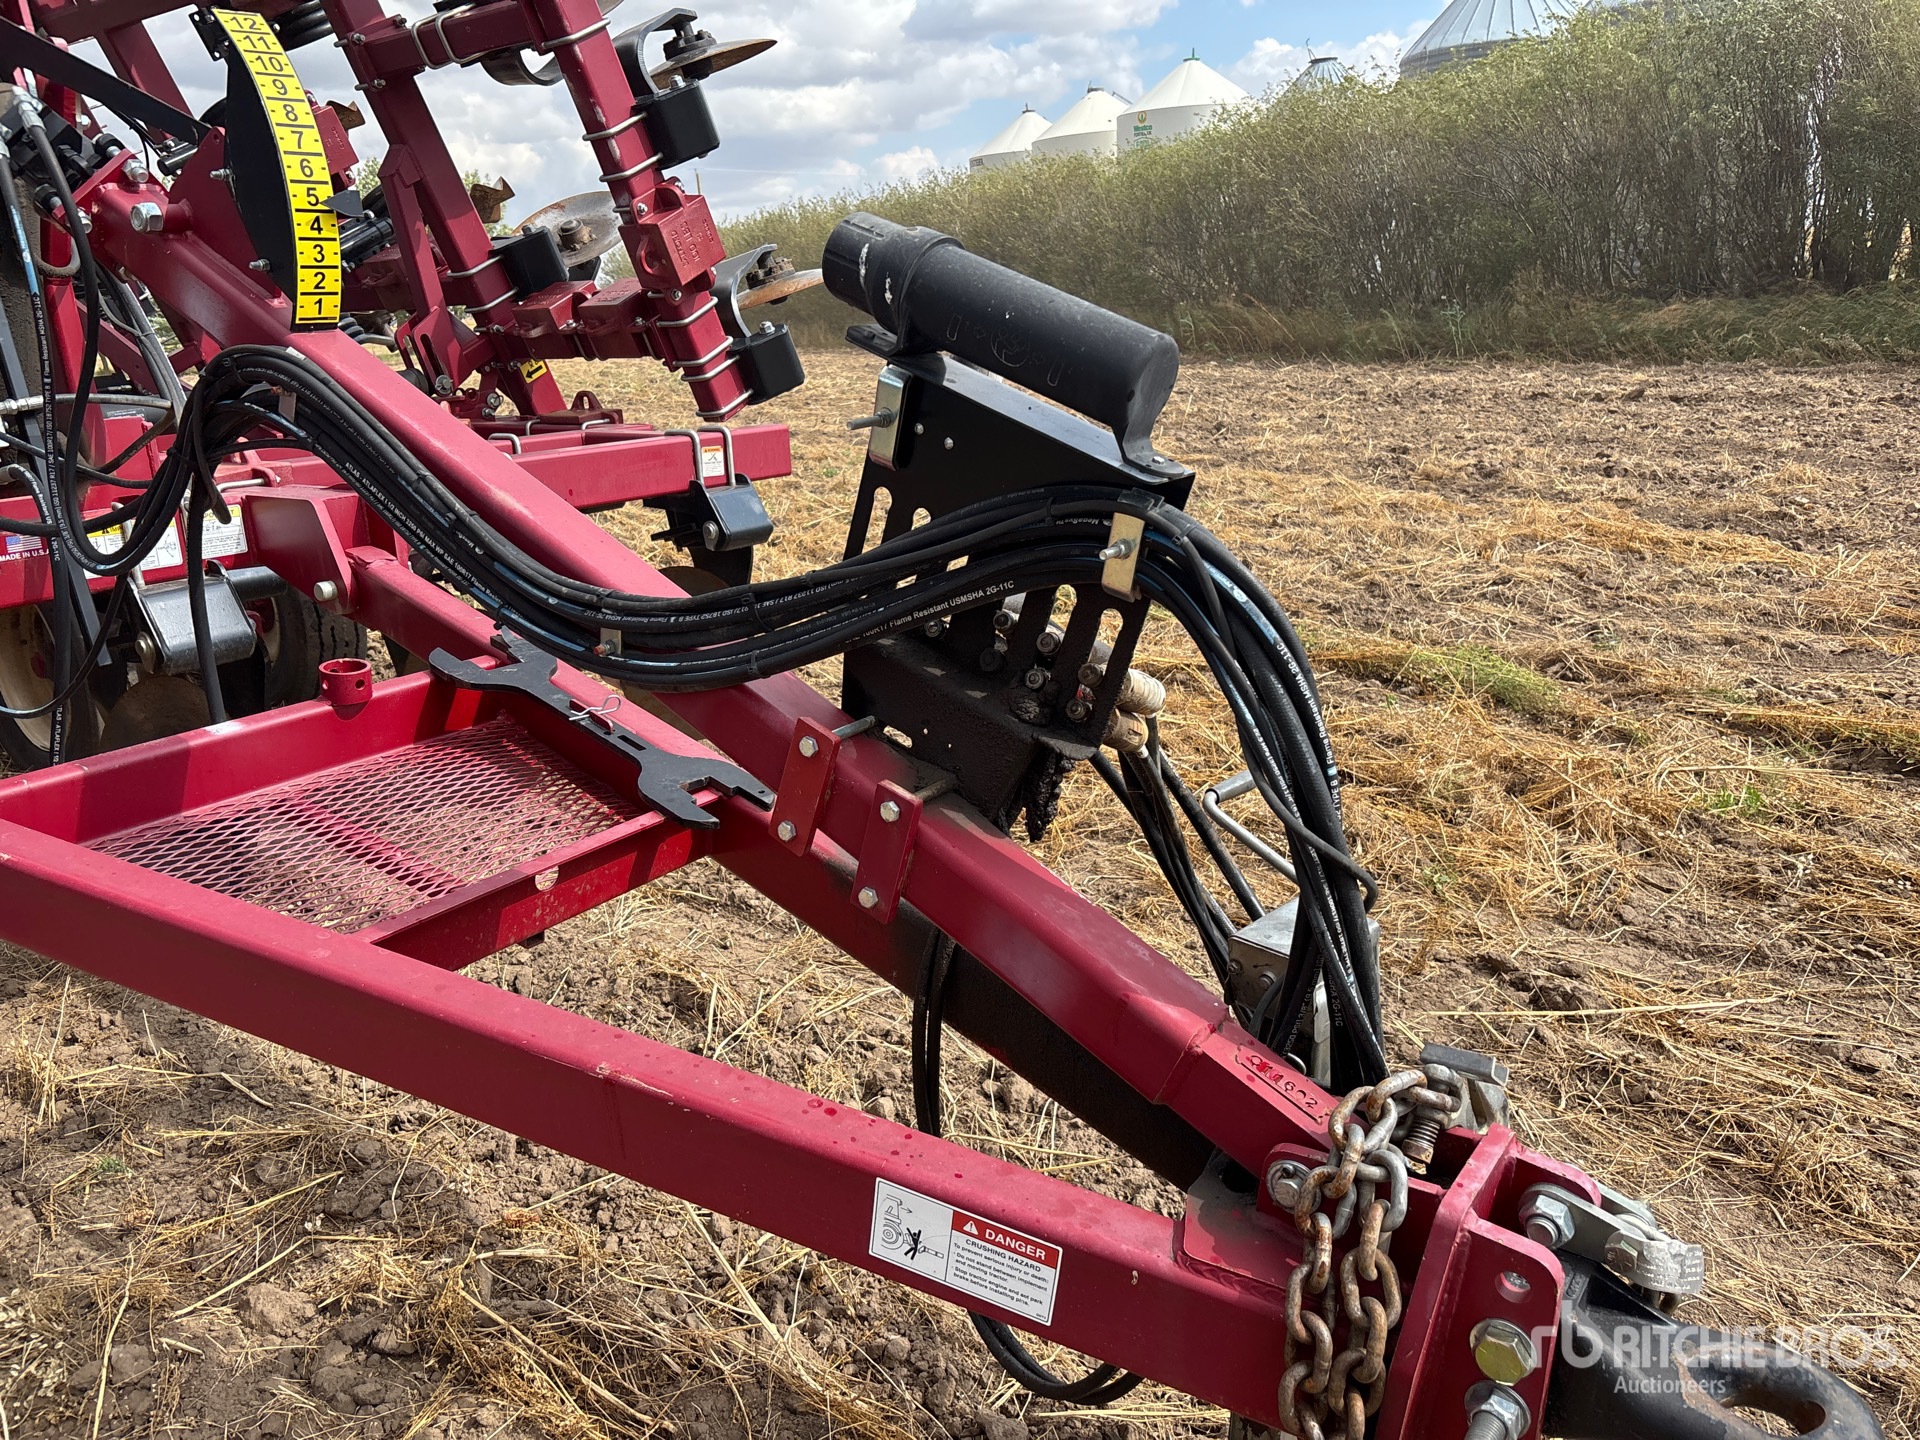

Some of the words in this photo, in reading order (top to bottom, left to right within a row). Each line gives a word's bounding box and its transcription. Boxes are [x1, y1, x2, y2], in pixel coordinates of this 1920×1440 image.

[230, 17, 261, 30] 12
[243, 35, 271, 50] 11
[256, 56, 284, 72] 10
[272, 79, 288, 96] 9
[283, 104, 298, 122] 8
[291, 131, 303, 149] 7
[300, 158, 313, 178] 6
[306, 188, 319, 206] 5
[310, 216, 323, 234] 4
[313, 244, 325, 263] 3
[314, 272, 325, 289] 2
[314, 298, 322, 315] 1
[40, 335, 48, 359] Resistant
[35, 493, 51, 516] Resistant
[344, 462, 361, 478] ATLAS
[360, 477, 387, 501] ATLAFLEX
[392, 507, 407, 520] INCH
[423, 536, 436, 548] MAX
[433, 544, 445, 555] WP
[441, 552, 455, 565] SAE
[469, 576, 487, 591] Flame
[912, 600, 949, 618] Resistant
[948, 589, 985, 606] USMSHA
[984, 580, 1014, 595] 2G-11C
[621, 613, 649, 624] Resistant
[649, 614, 668, 624] Flame
[1275, 640, 1299, 675] 2G-11C
[1293, 672, 1312, 698] MSHA
[1303, 697, 1329, 737] Resistant
[1322, 737, 1334, 764] Flame
[1330, 997, 1343, 1027] 2G-11C
[985, 1228, 1046, 1260] DANGER
[960, 1246, 983, 1258] prevent
[983, 1255, 1005, 1266] serious
[1005, 1263, 1022, 1273] injury
[966, 1238, 1007, 1259] CRUSHING
[1008, 1254, 1041, 1272] HAZARD
[954, 1266, 968, 1274] Stop
[968, 1272, 987, 1282] tractor
[987, 1280, 1007, 1291] engine
[966, 1263, 988, 1275] moving
[975, 1260, 992, 1269] stand
[992, 1266, 1016, 1279] between
[1016, 1276, 1048, 1292] implement
[952, 1272, 969, 1281] brake
[969, 1278, 988, 1289] before
[988, 1286, 1015, 1300] installing
